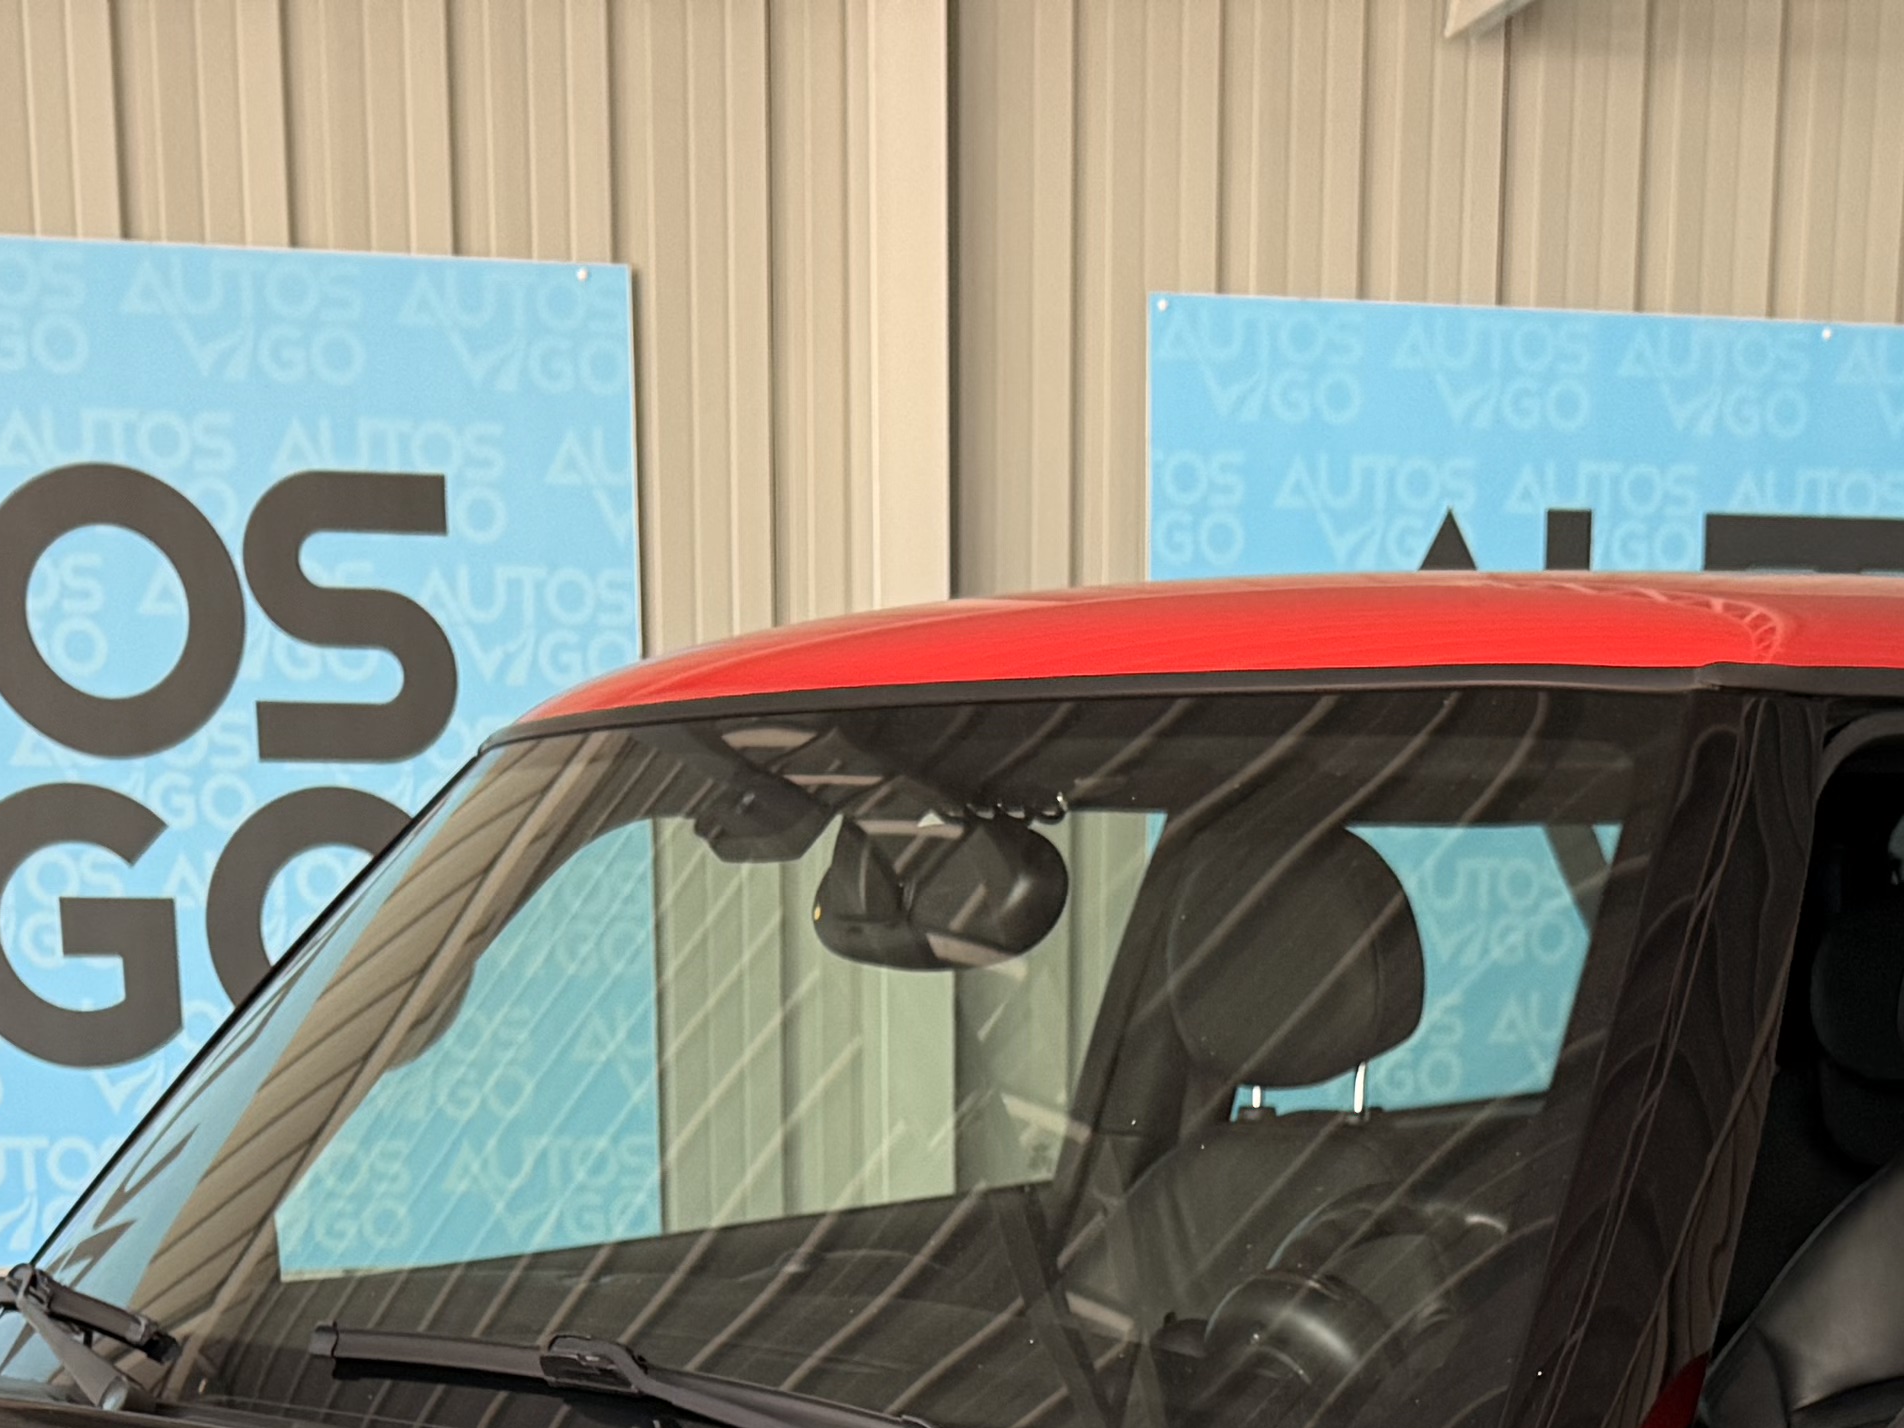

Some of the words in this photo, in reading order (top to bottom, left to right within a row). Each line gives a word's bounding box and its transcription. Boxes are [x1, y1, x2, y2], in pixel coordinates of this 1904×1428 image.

[119, 253, 363, 322] AUTOS
[397, 264, 629, 332] AUTOS
[1275, 451, 1478, 512] AUTOS
[418, 563, 633, 628] AUTOS
